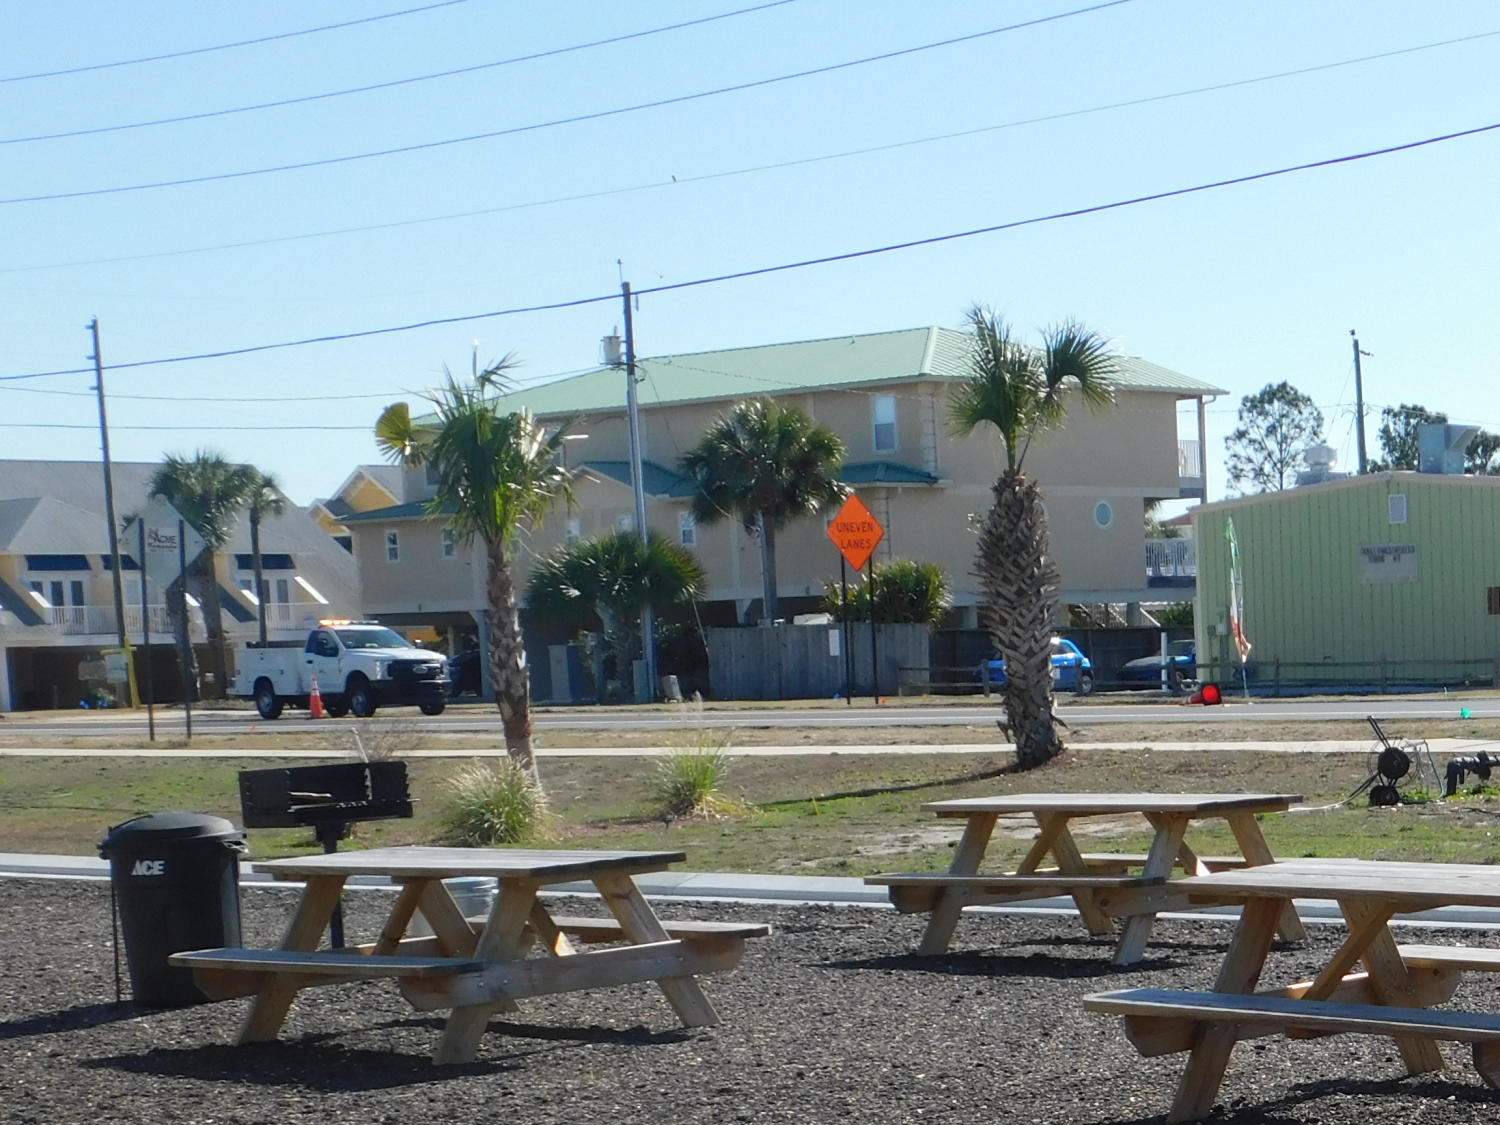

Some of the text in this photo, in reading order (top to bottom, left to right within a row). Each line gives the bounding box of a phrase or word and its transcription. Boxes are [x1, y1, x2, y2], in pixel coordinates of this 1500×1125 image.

[836, 521, 874, 533] UNEVEN
[840, 538, 872, 550] LANES
[131, 859, 165, 876] ACE
